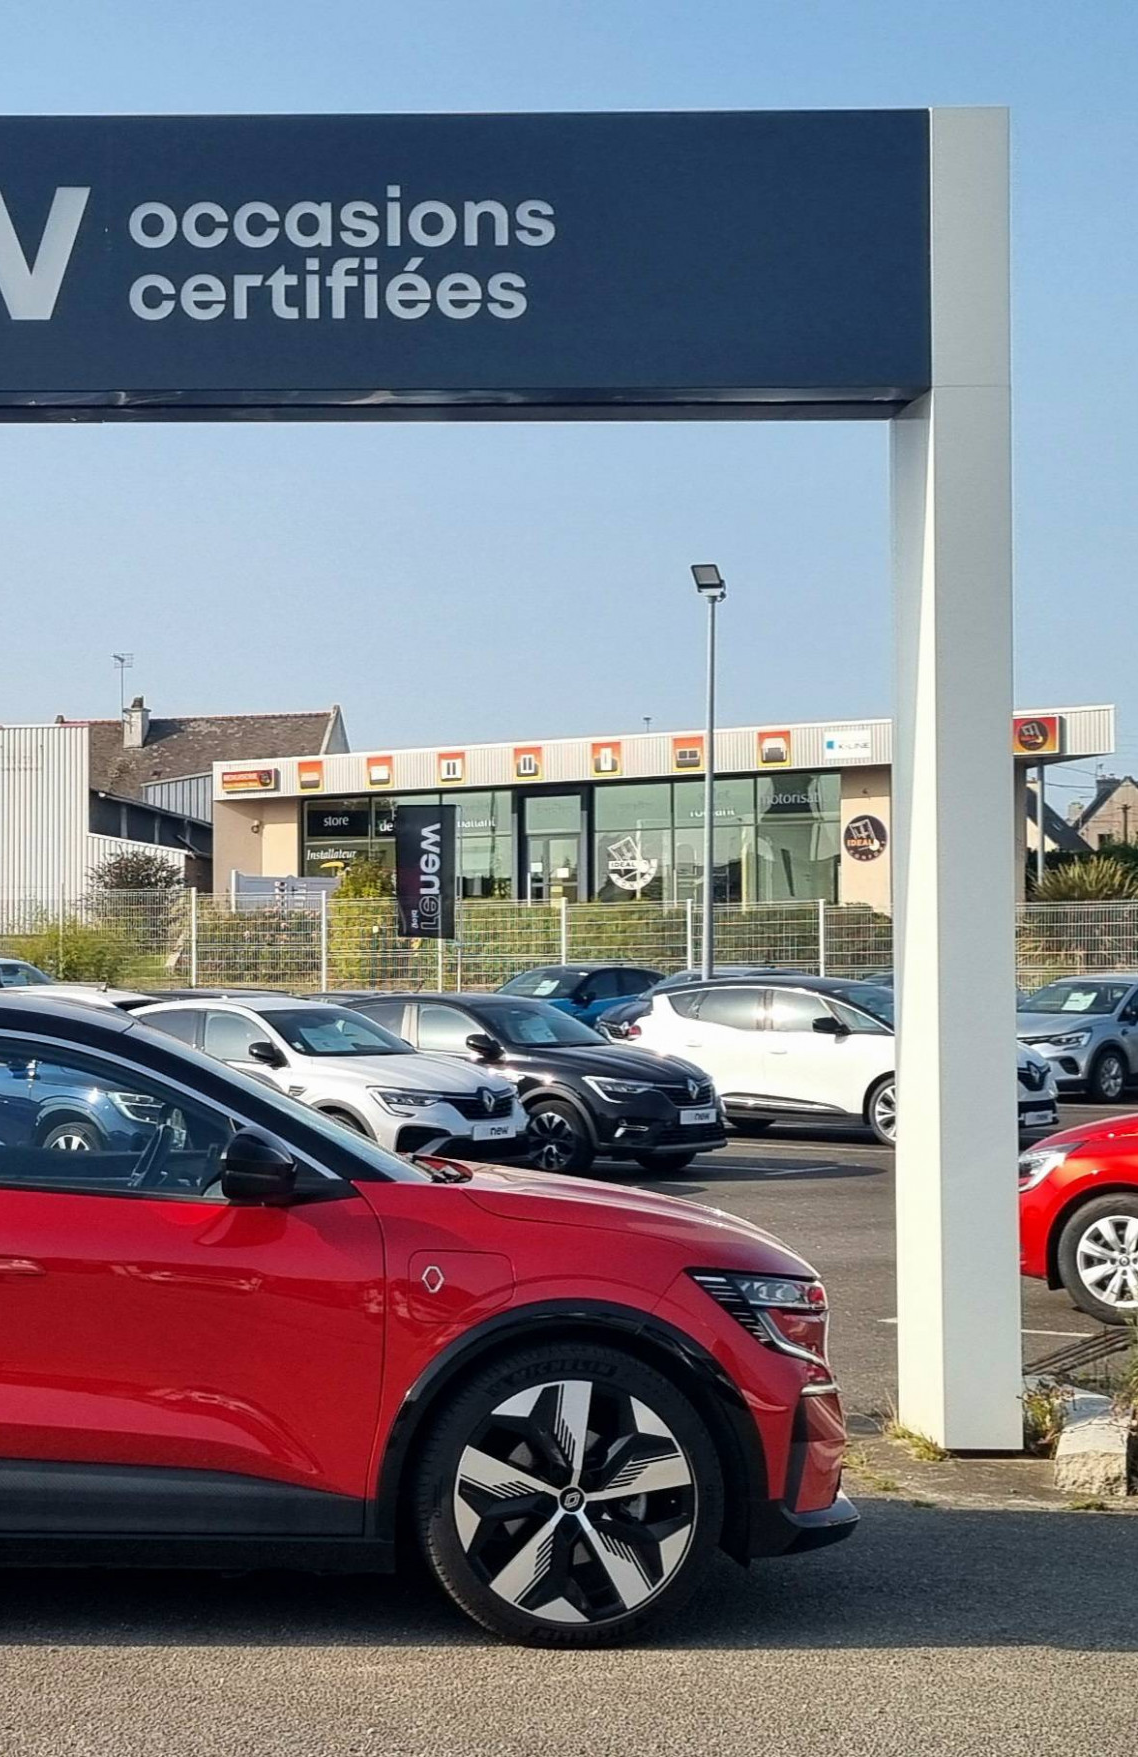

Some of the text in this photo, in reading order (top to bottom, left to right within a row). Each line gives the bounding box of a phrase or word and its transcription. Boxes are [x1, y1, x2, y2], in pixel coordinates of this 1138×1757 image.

[129, 185, 556, 248] occasions
[129, 257, 528, 320] certifiées
[323, 816, 350, 827] store
[306, 848, 358, 860] Installateur
